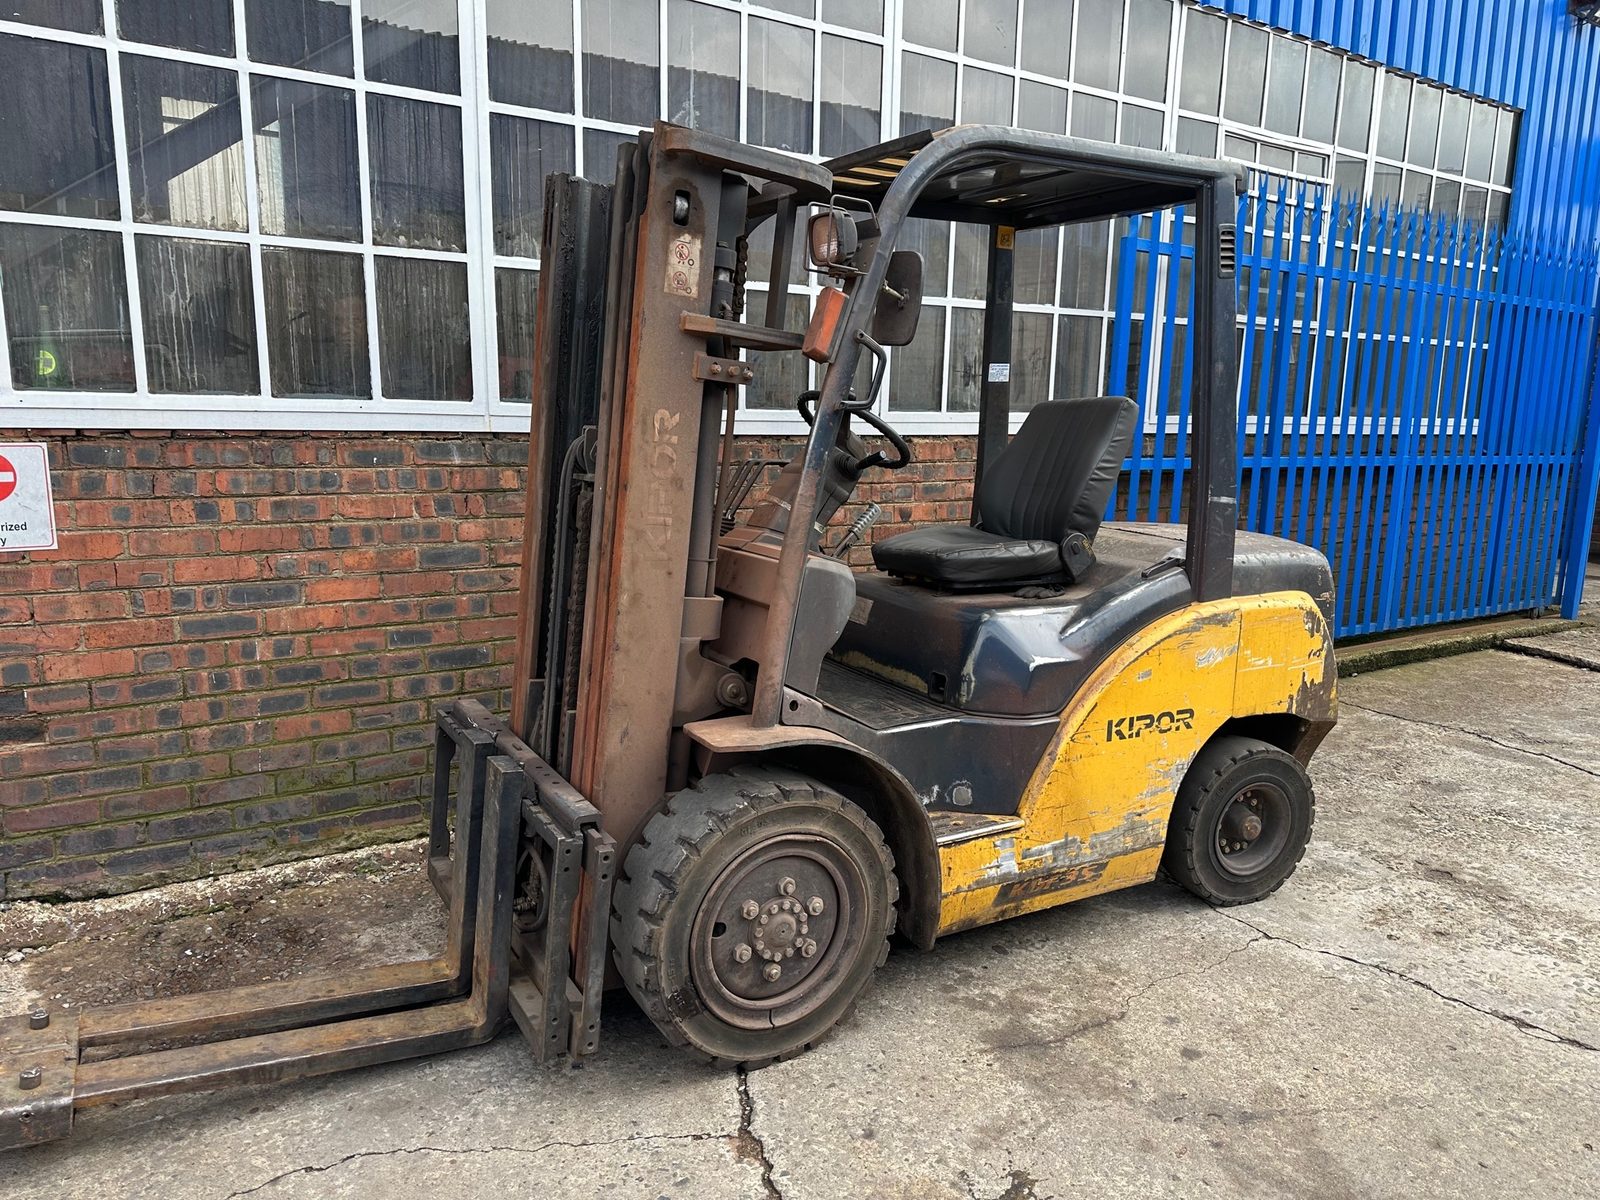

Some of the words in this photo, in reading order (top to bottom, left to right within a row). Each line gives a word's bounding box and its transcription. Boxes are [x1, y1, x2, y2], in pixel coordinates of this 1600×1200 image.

[644, 408, 681, 561] KIPOR
[1, 521, 27, 531] rized
[1106, 708, 1195, 742] KIPOR
